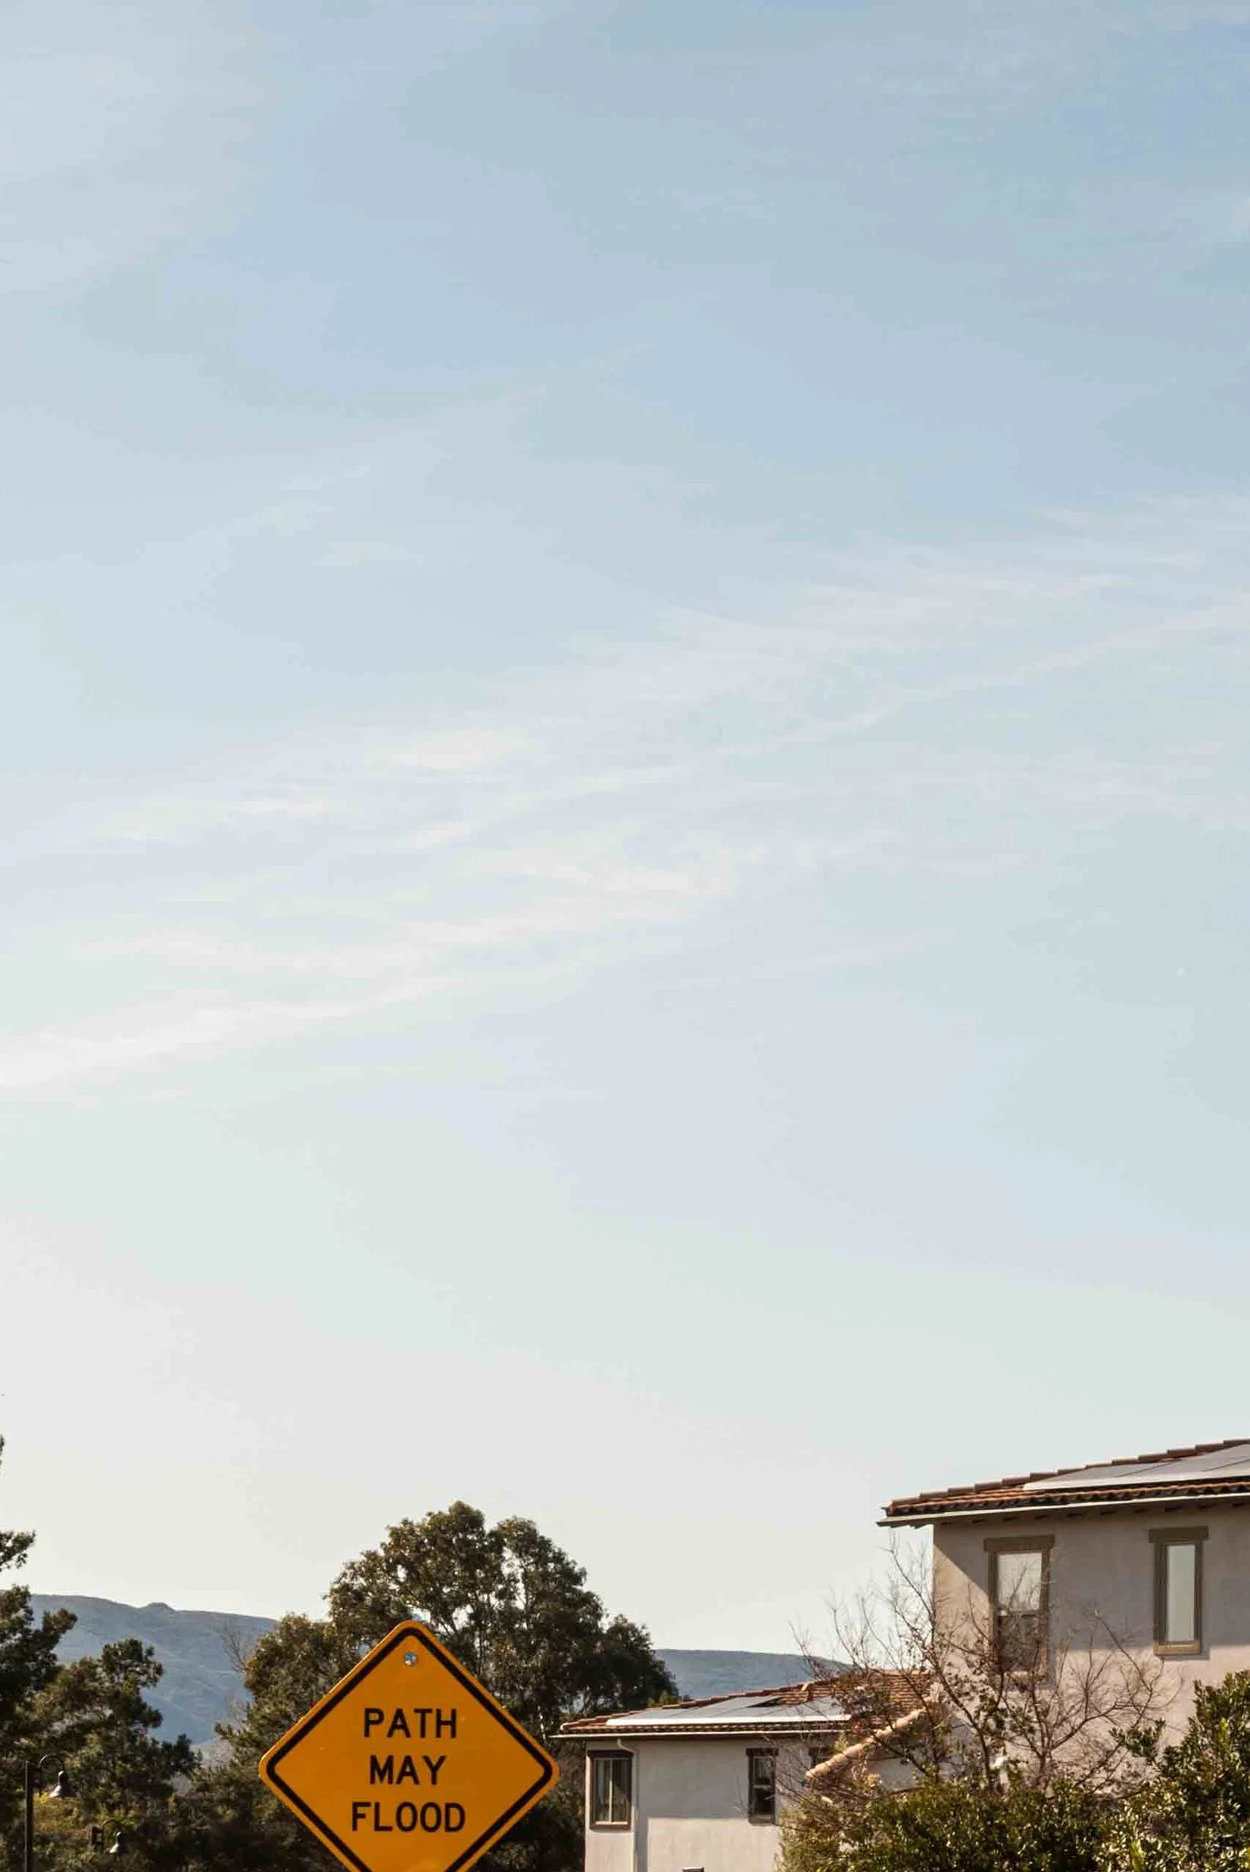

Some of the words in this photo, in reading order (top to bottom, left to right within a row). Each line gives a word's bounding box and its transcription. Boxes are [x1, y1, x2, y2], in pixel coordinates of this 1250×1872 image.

[363, 1708, 457, 1738] PATH
[369, 1755, 446, 1785] MAY
[351, 1802, 466, 1832] FLOOD
